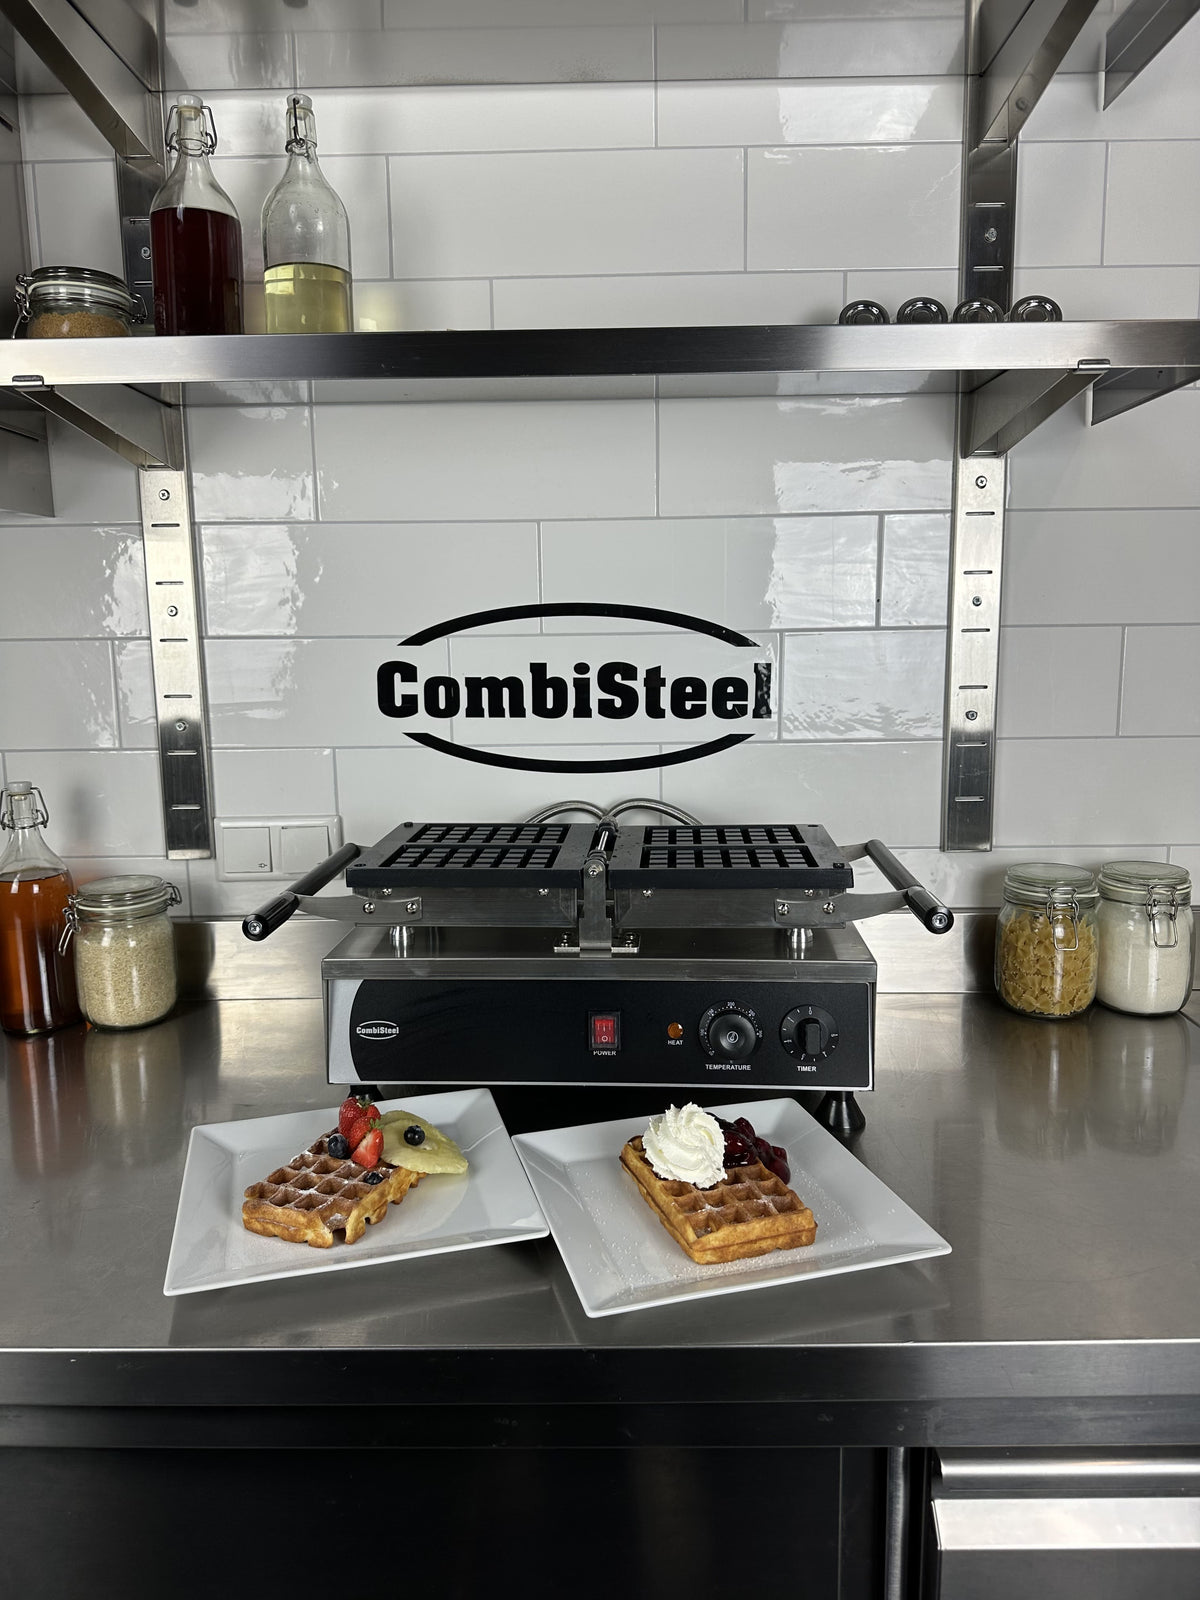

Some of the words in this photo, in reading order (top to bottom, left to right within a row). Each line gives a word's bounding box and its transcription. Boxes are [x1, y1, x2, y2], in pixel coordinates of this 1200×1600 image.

[376, 660, 772, 719] CombiSteel
[356, 1026, 400, 1034] CombiSteel
[705, 1063, 752, 1071] TEMPERATURE
